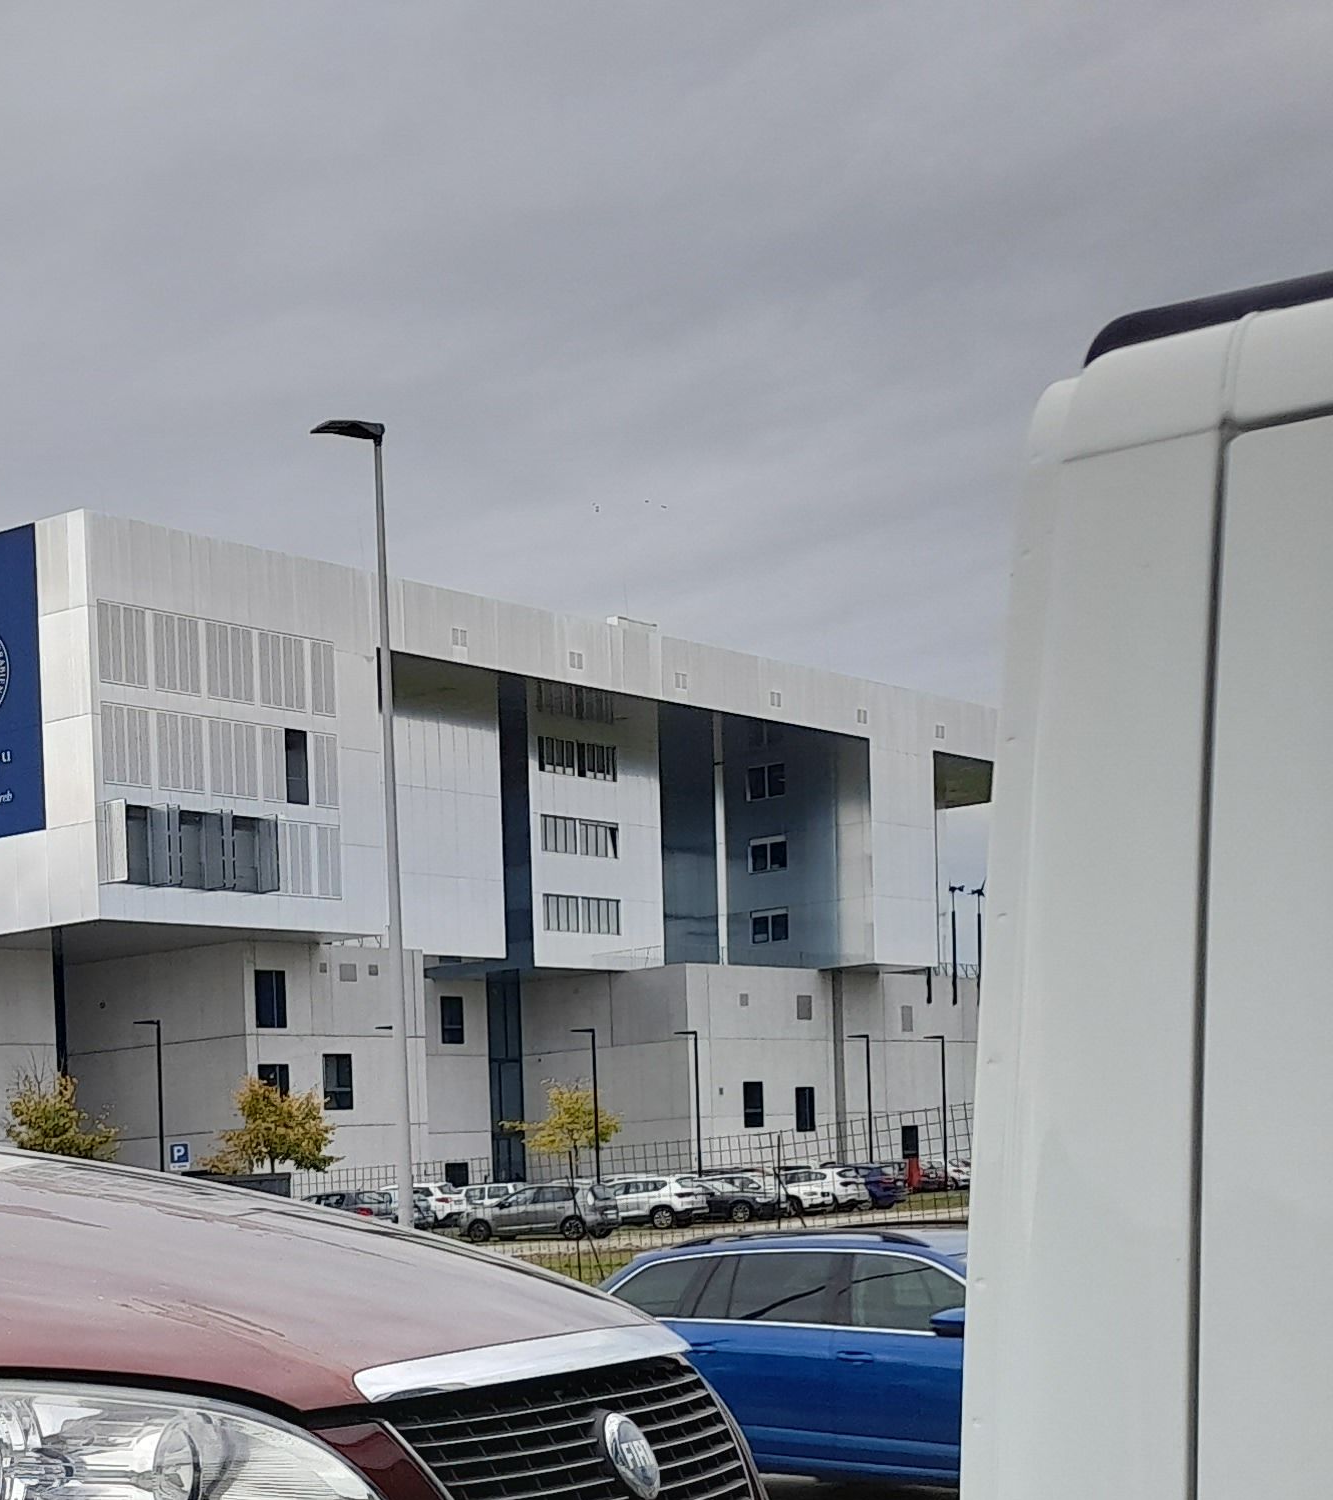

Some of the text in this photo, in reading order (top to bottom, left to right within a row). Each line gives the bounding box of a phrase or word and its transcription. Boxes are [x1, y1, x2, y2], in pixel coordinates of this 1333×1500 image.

[1, 750, 12, 763] u
[173, 1145, 185, 1162] P
[620, 1439, 658, 1470] FIAT
